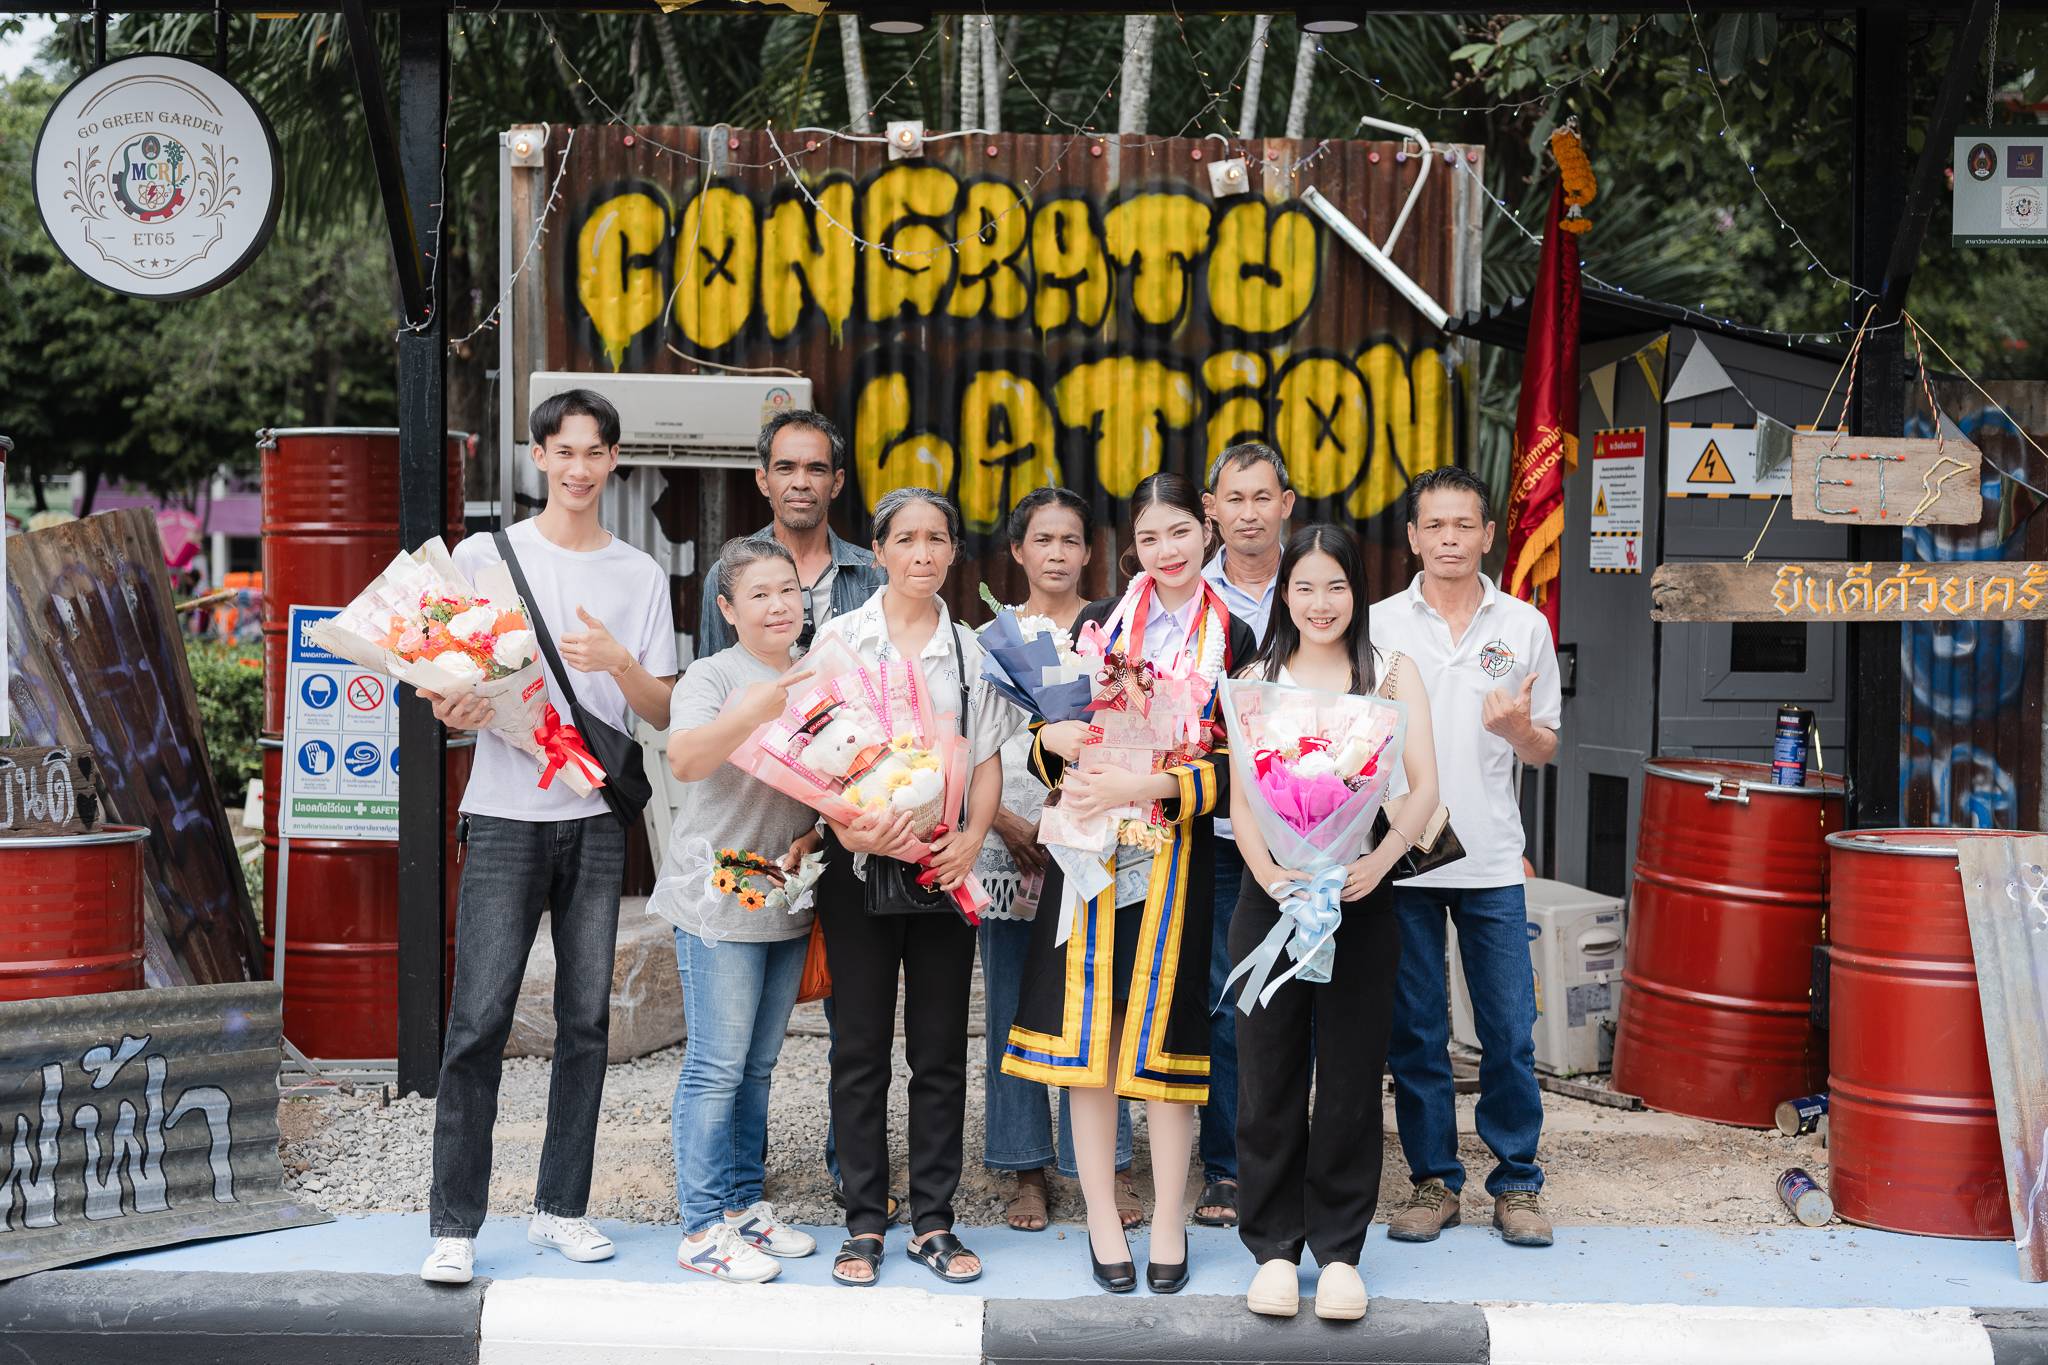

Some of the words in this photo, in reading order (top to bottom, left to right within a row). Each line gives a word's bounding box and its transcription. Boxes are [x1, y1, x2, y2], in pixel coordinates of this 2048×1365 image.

[77, 122, 99, 139] GO
[102, 111, 154, 129] GREEN
[158, 111, 223, 136] GARDEN
[133, 231, 175, 247] ET65
[1815, 452, 1905, 519] ET
[370, 805, 399, 814] SAFETY
